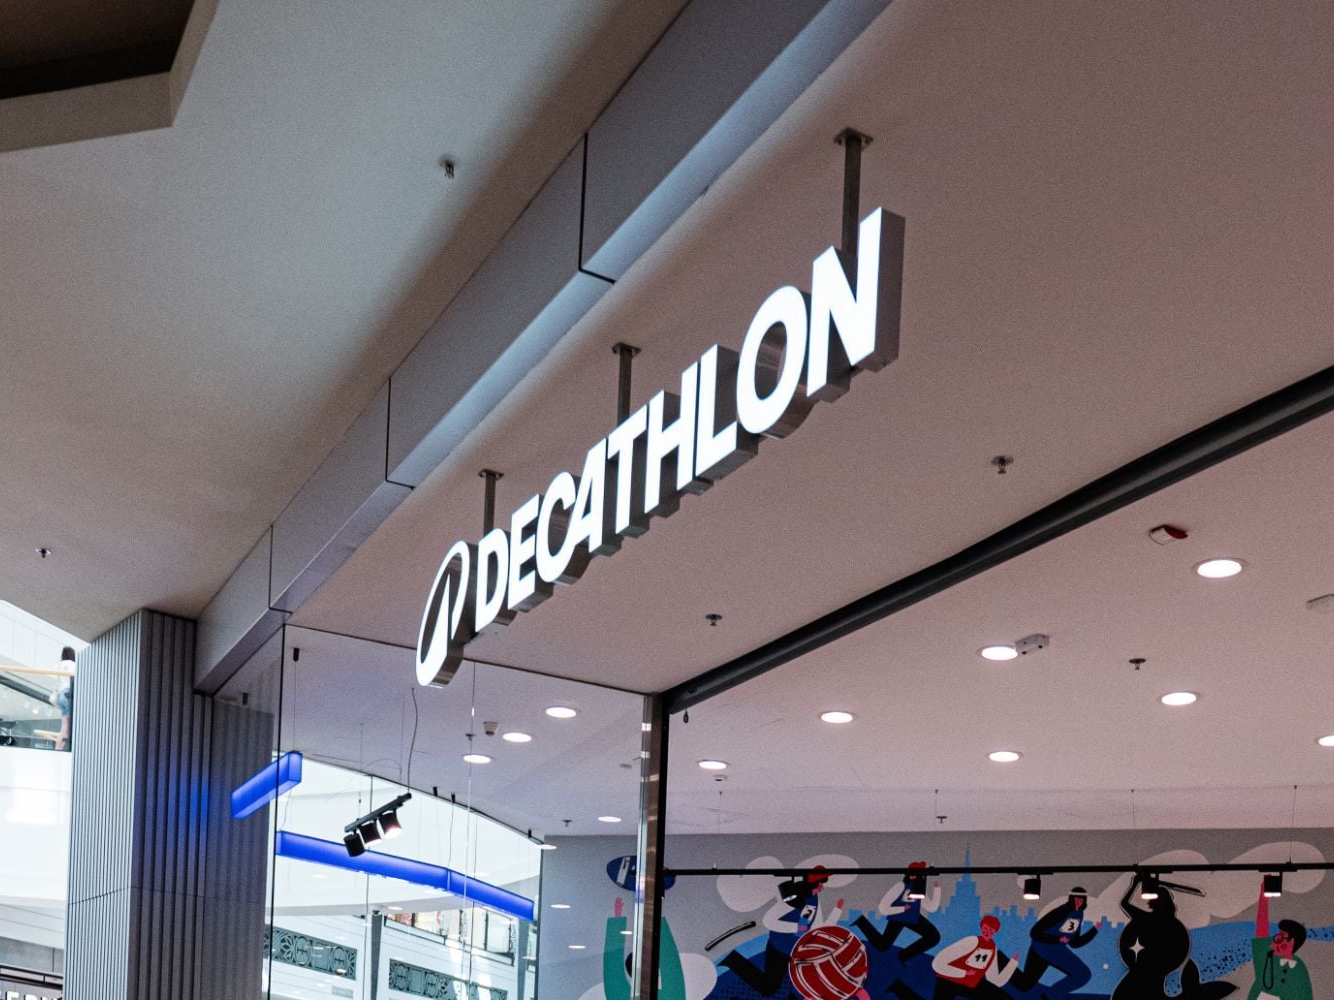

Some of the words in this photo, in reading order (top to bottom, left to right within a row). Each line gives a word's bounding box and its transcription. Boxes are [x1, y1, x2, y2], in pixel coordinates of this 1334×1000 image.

[475, 206, 883, 633] DECATHLON
[1067, 921, 1075, 931] 3
[975, 953, 988, 962] 11
